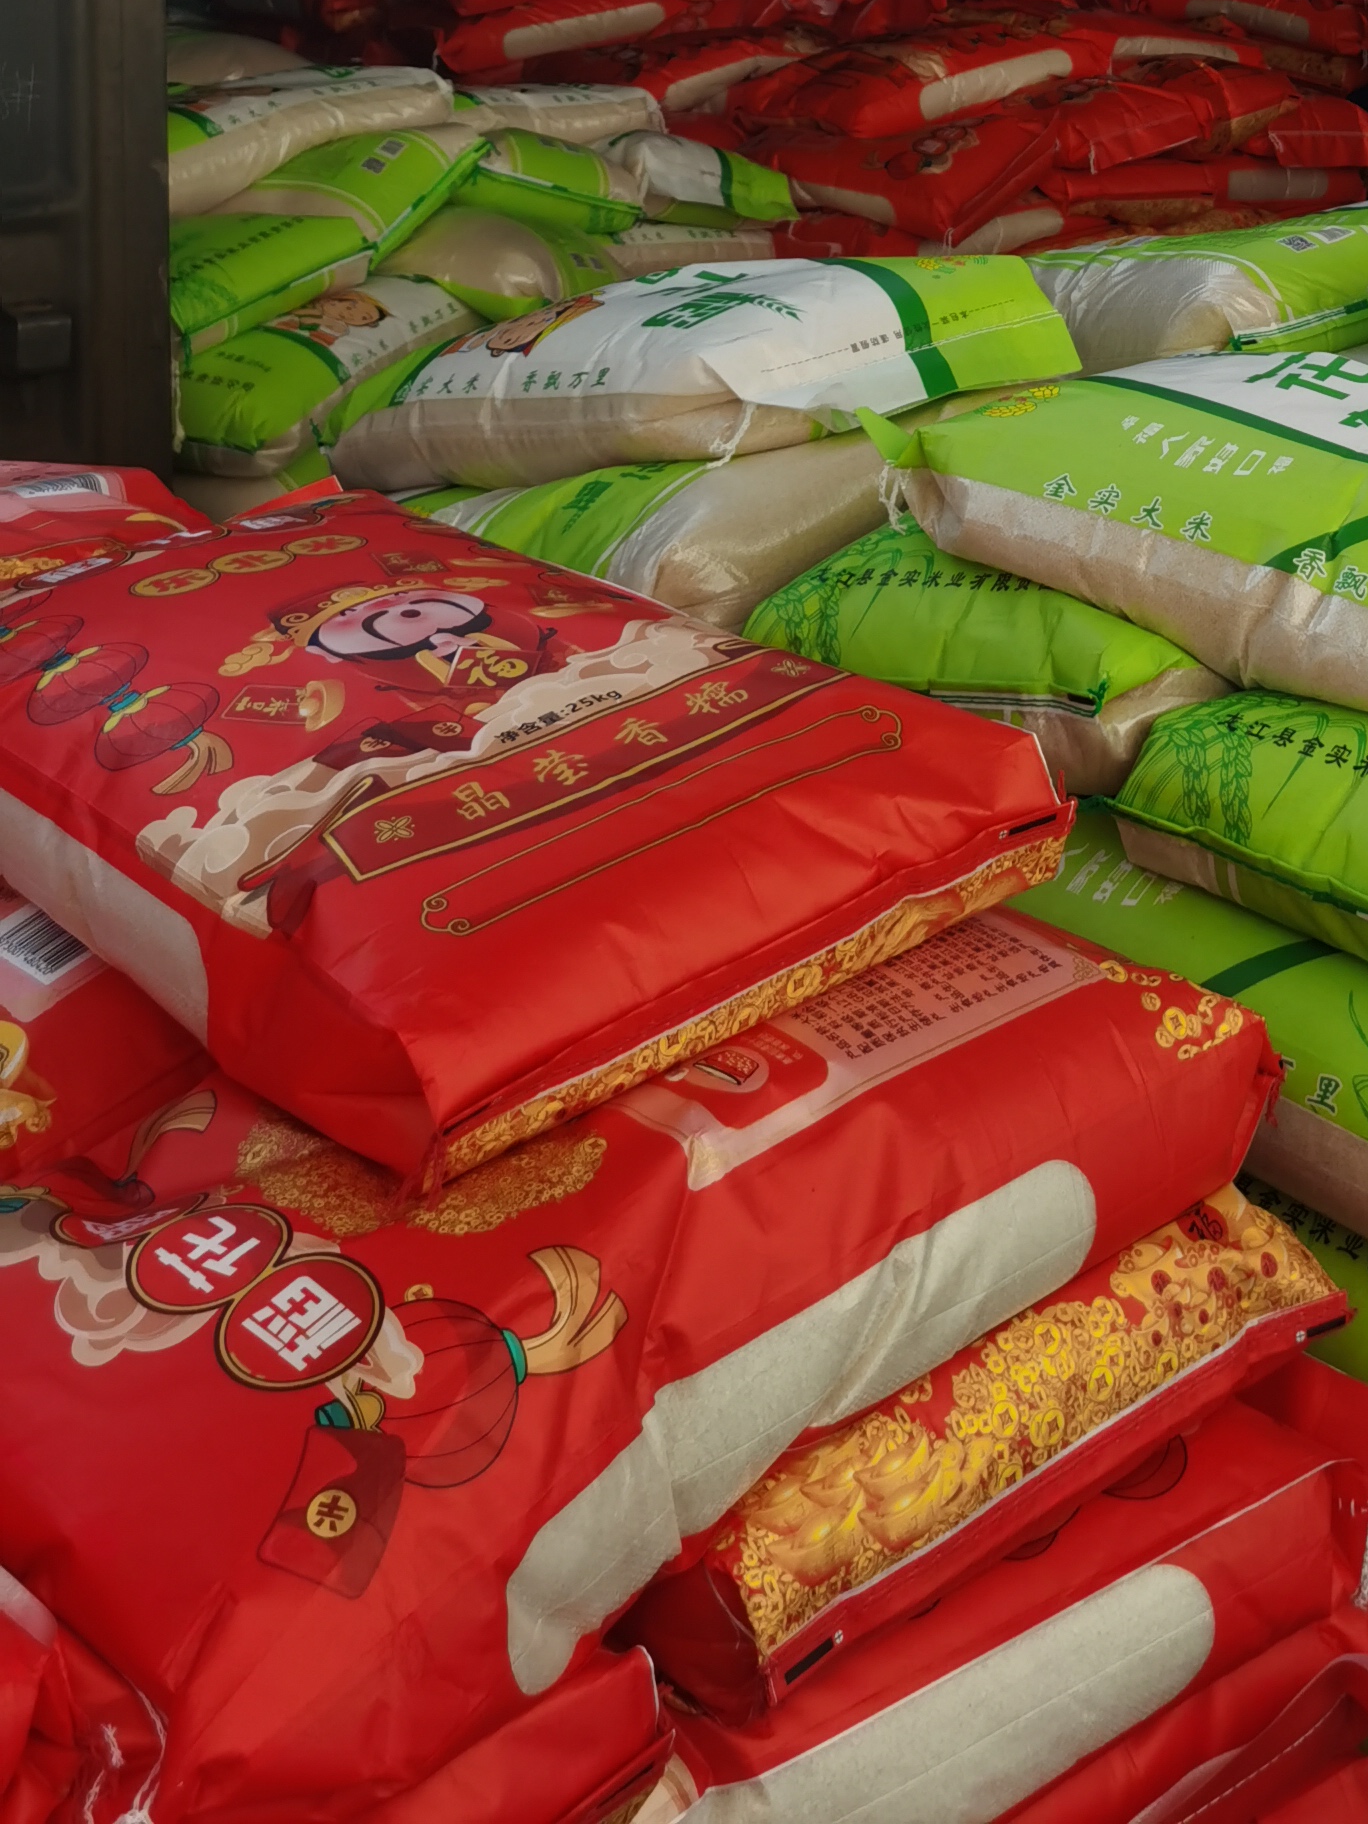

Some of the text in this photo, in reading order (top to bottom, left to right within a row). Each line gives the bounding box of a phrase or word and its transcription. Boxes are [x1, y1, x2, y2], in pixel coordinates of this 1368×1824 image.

[522, 366, 611, 393] 香飘万里
[1042, 472, 1212, 541] 金实大米
[809, 567, 1055, 592] 龙江县金实米业有限责
[494, 690, 623, 744] 净含量:25kg
[451, 680, 749, 822] 晶莹香糯
[788, 1009, 862, 1060] 产品名称:大米
